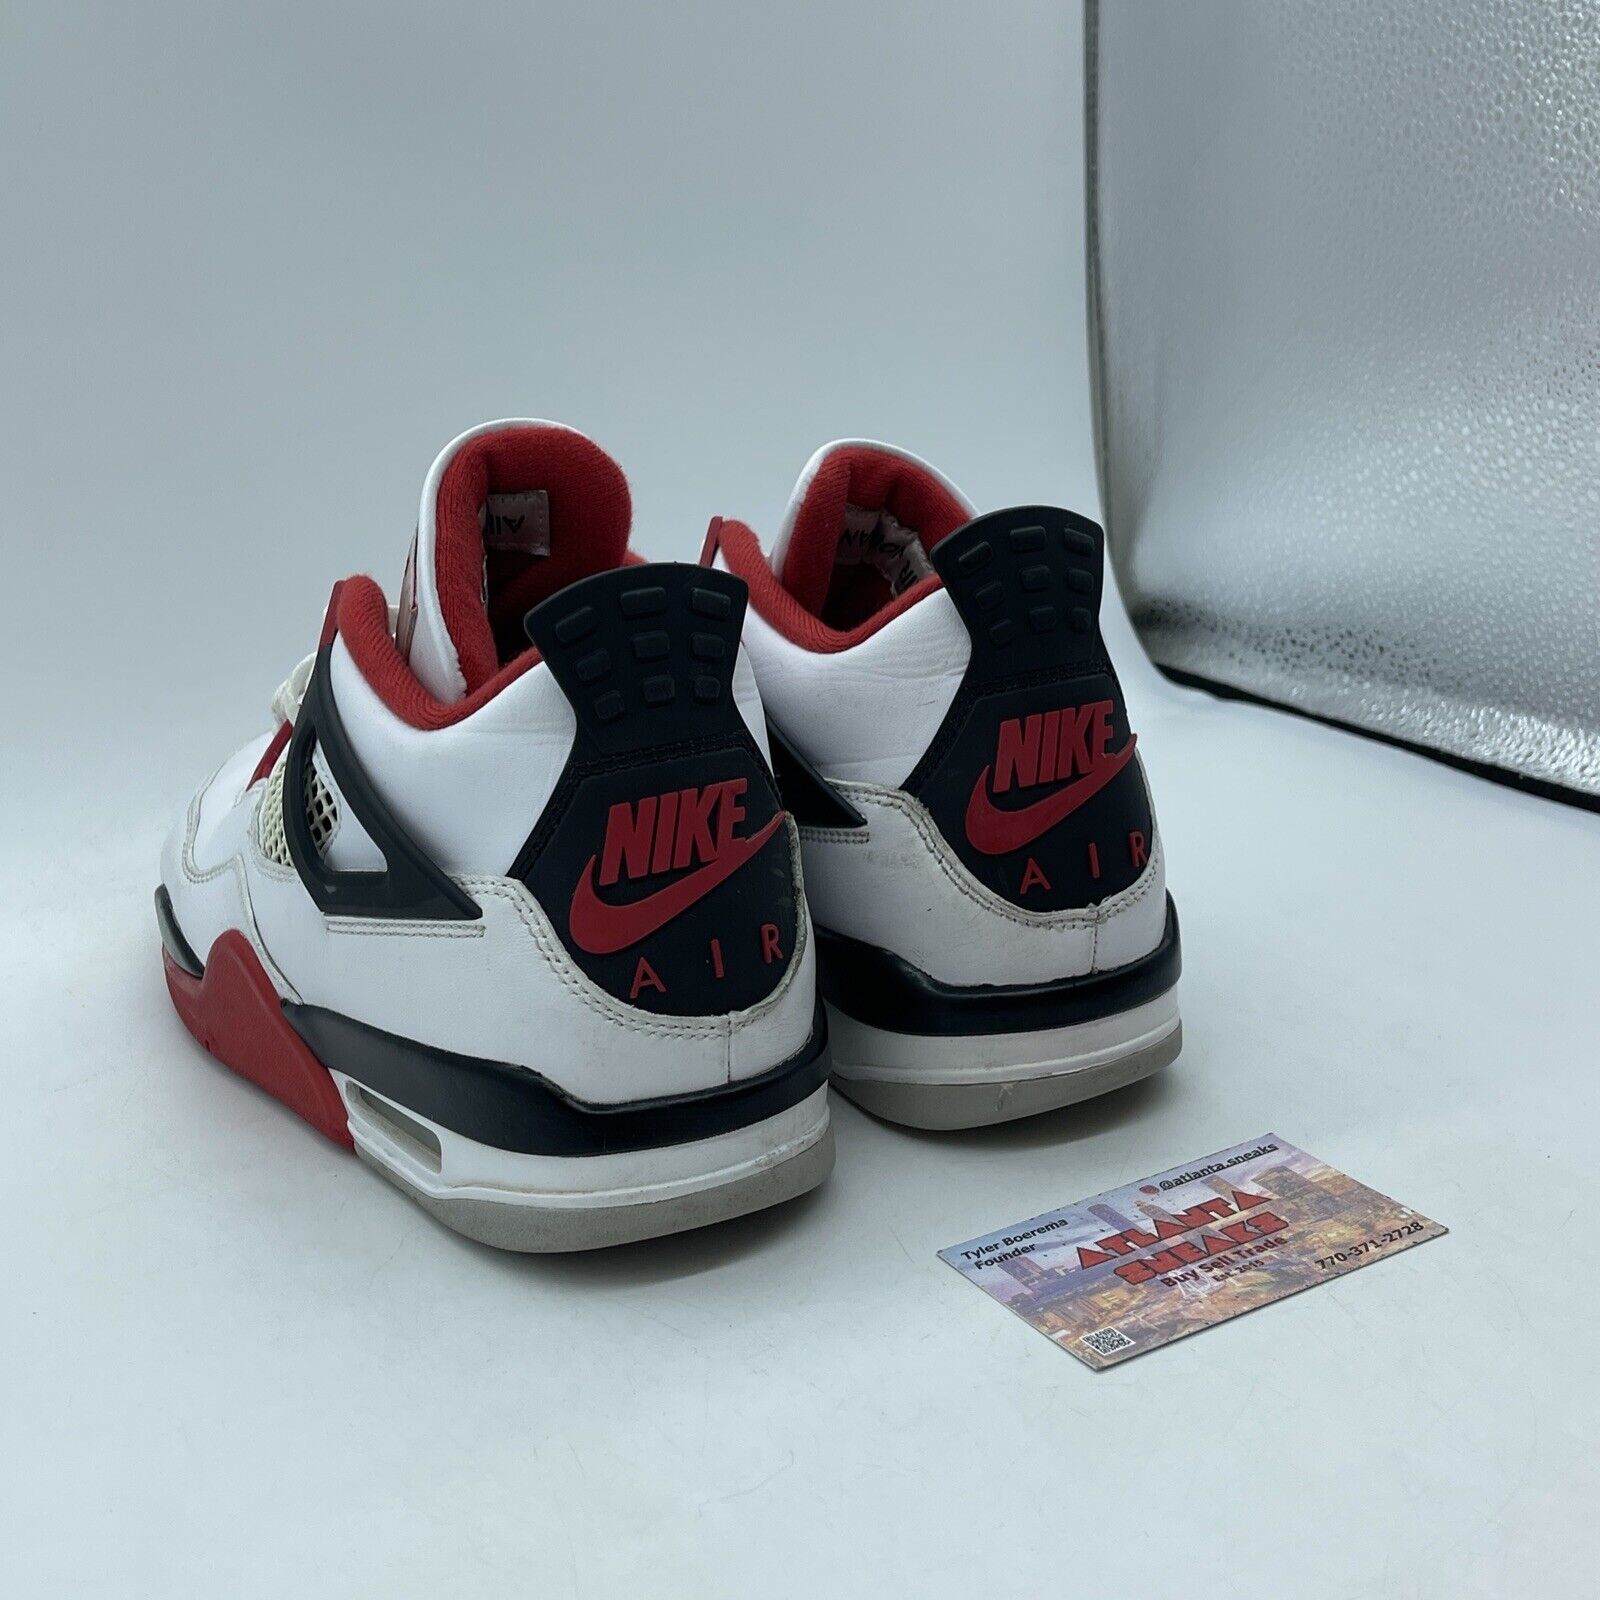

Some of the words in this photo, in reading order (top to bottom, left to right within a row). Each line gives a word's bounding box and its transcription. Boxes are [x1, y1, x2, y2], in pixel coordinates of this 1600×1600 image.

[997, 698, 1114, 794] NIKE
[600, 777, 748, 886] NIKE
[1019, 829, 1148, 895] AIR
[629, 922, 784, 999] AIR
[1158, 1142, 1279, 1192] @atlanta.sneaks
[960, 1242, 1000, 1260] Tyler
[1001, 1218, 1069, 1246] Boerema
[973, 1242, 1036, 1270] Founder
[1076, 1190, 1272, 1271] ATLANTA
[1113, 1211, 1289, 1286] SNEAKS
[1160, 1268, 1200, 1287] Buy
[1198, 1254, 1236, 1273] Sell
[1232, 1236, 1288, 1260] Trade
[1314, 1221, 1425, 1270] 770-371-2728
